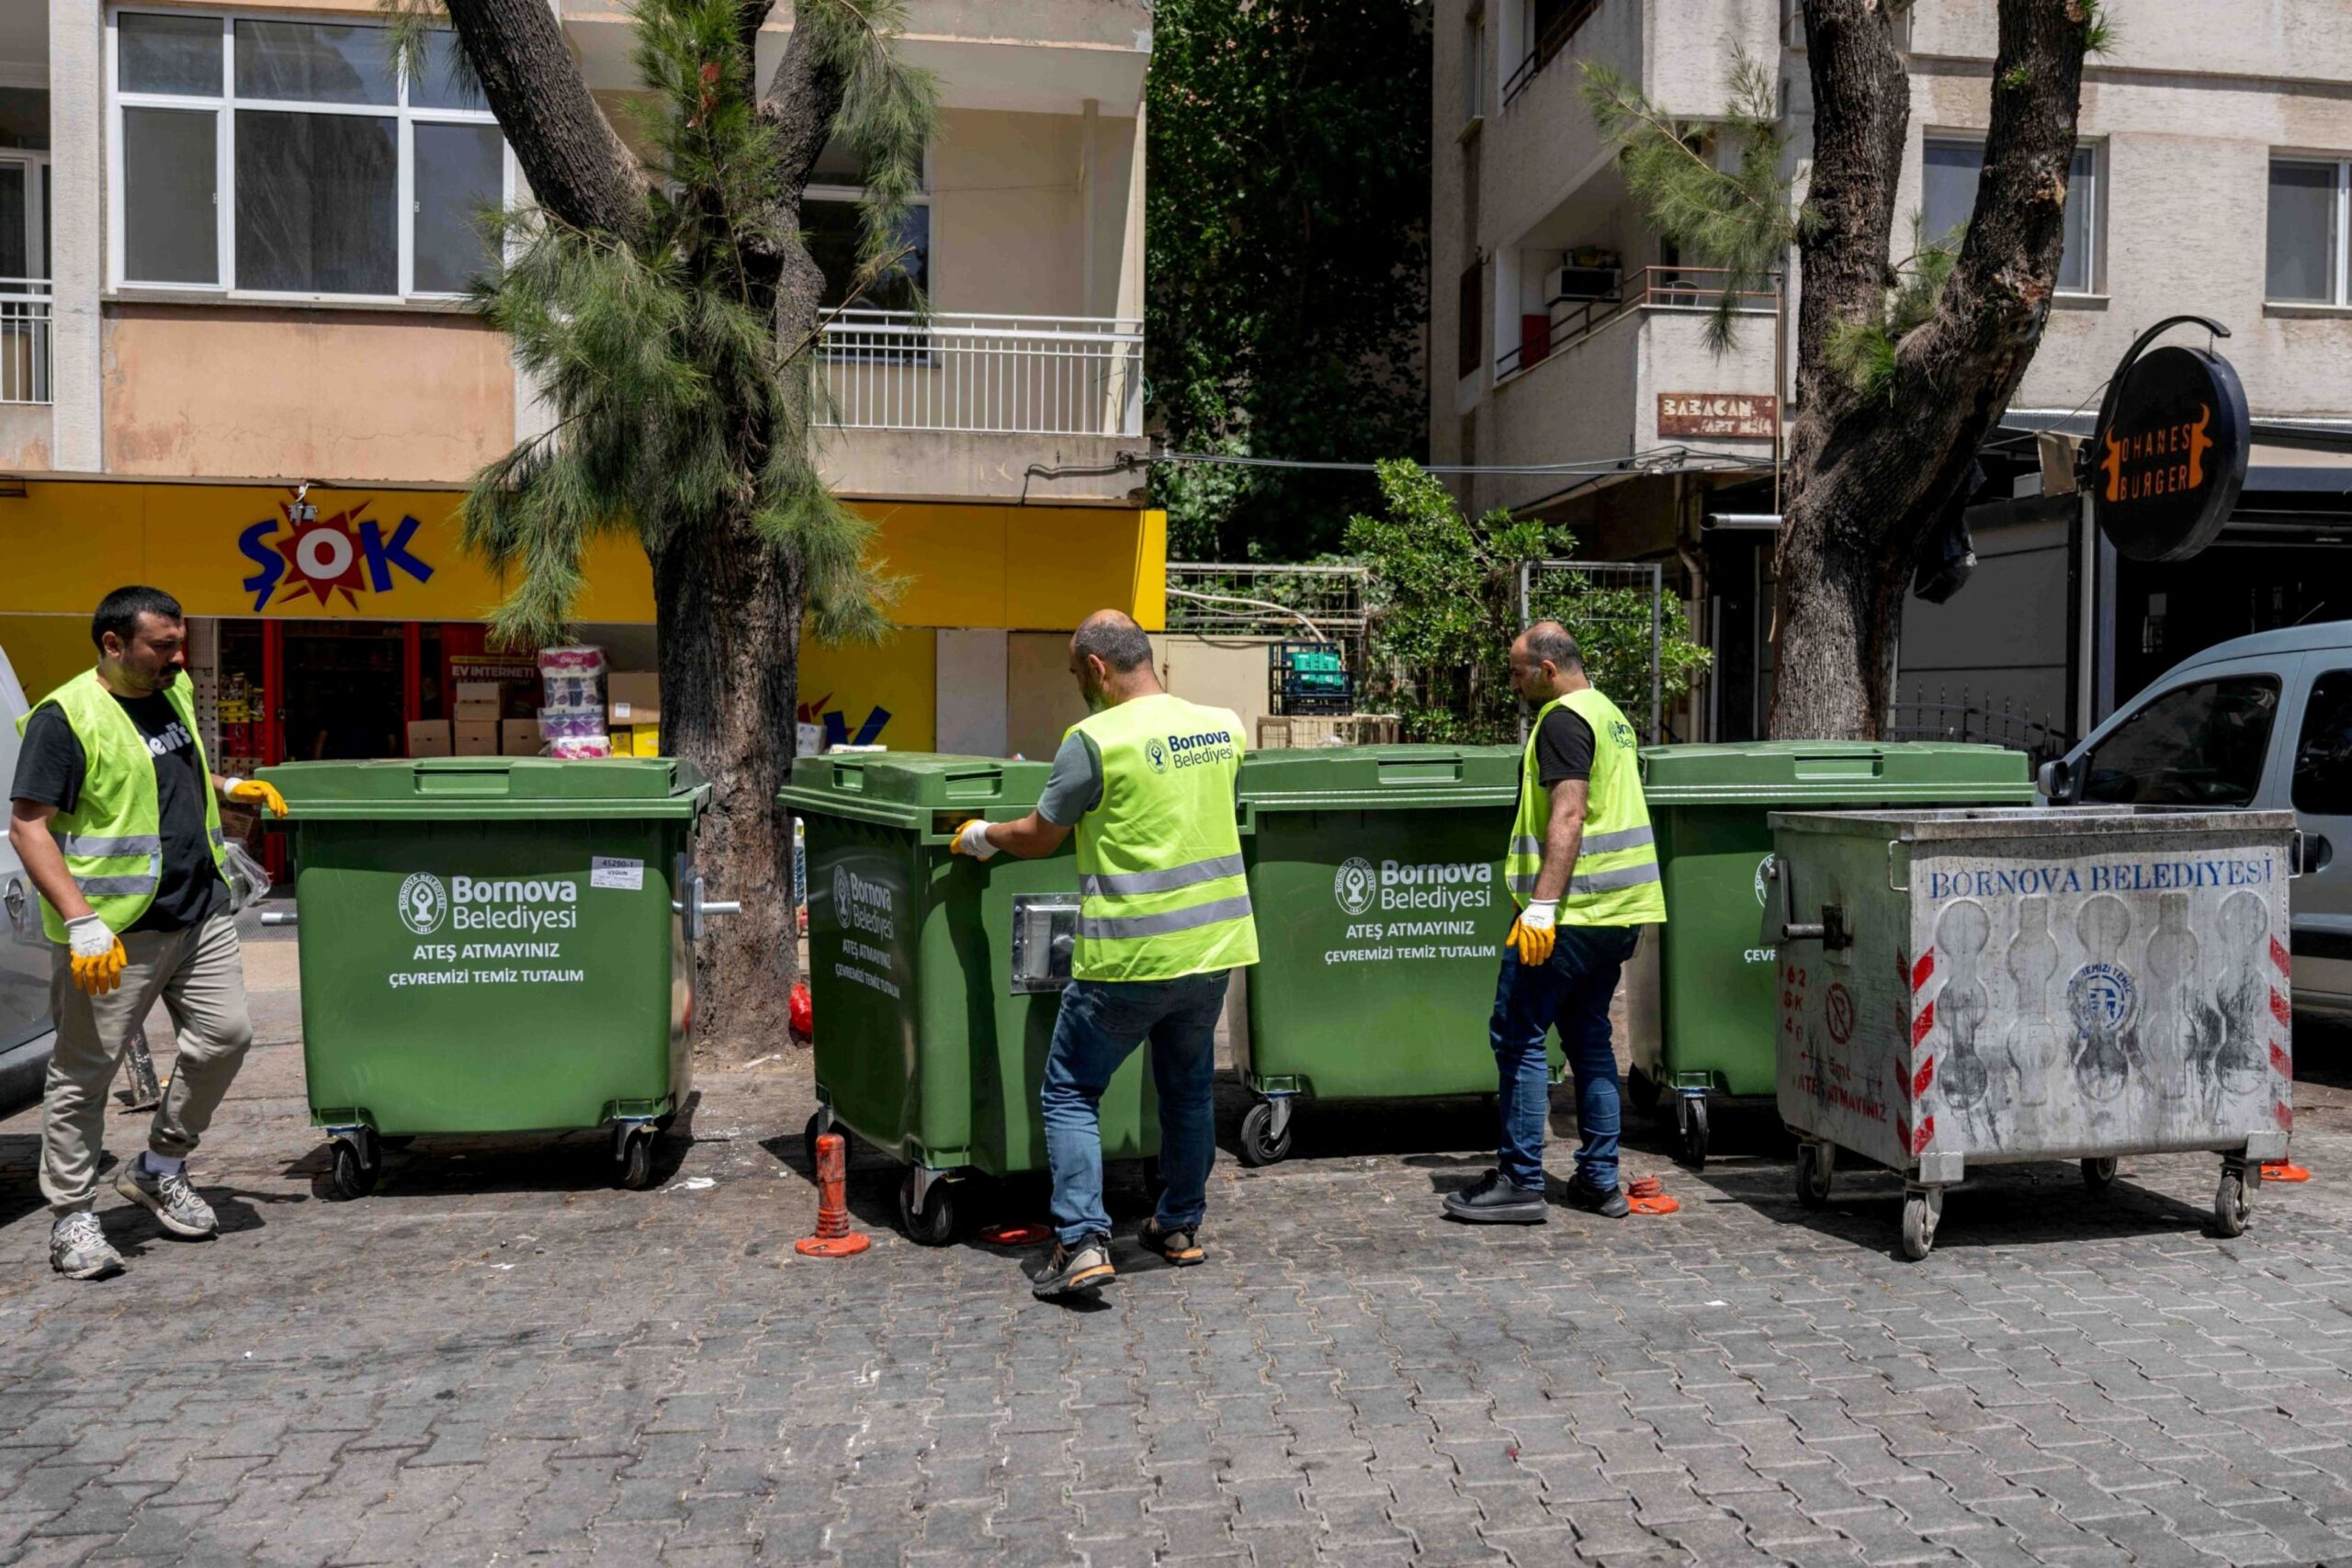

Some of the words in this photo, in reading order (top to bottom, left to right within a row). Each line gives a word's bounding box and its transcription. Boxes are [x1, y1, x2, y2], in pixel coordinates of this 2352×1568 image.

[1663, 399, 1752, 417] BABACAN
[2120, 465, 2188, 501] BURGER
[238, 514, 435, 613] ŞOK
[452, 665, 469, 677] EV
[1168, 730, 1231, 752] Bornova
[1173, 744, 1234, 769] Belediyesi
[1381, 860, 1492, 886] Bornova
[1929, 867, 2082, 899] BORNOVA
[452, 875, 577, 903] Bornova
[850, 873, 892, 911] Bornova
[1381, 886, 1491, 912] Belediyesi
[453, 905, 577, 933] Belediyesi
[854, 904, 894, 941] Belediyesi
[1345, 923, 1384, 940] ATEŞ
[1387, 920, 1476, 937] ATMAYINIZ
[413, 944, 457, 962] ATEŞ
[461, 942, 560, 959] ATMAYINIZ
[842, 939, 859, 960] ATEŞ
[1325, 945, 1393, 964] ÇEVREMİZİ
[1396, 944, 1436, 959] TEMİZ
[1439, 945, 1496, 958] TUTALIM
[389, 969, 469, 987] ÇEVREMİZİ
[473, 968, 517, 983] TEMİZ
[521, 969, 584, 982] TUTALIM
